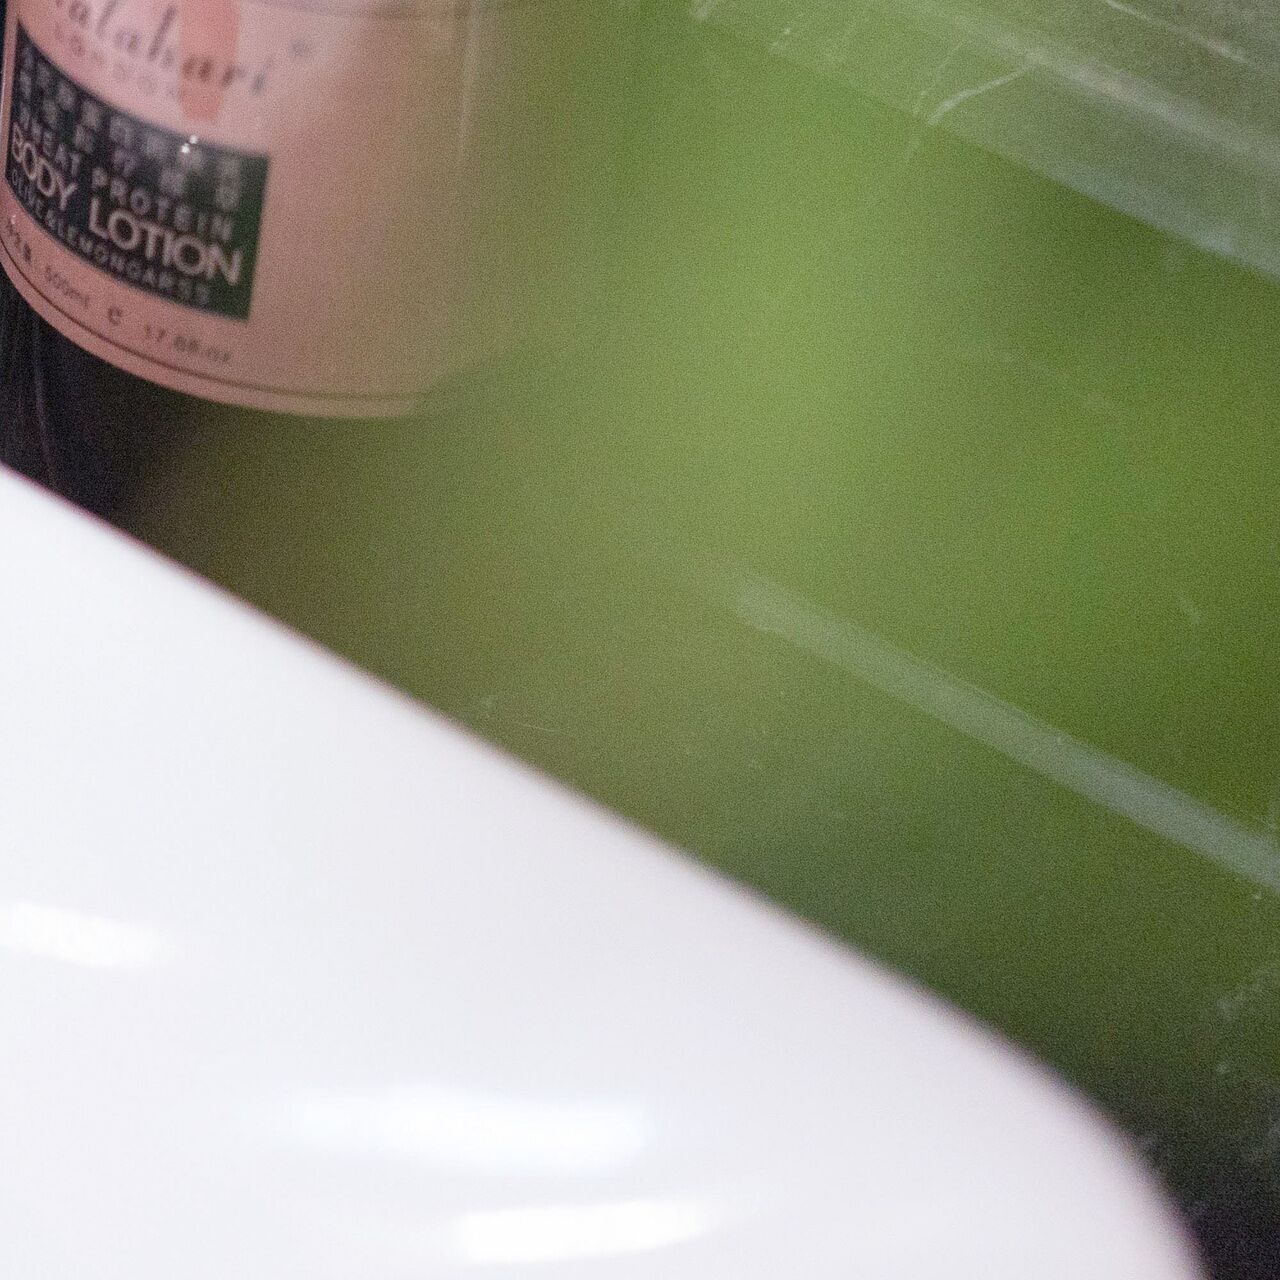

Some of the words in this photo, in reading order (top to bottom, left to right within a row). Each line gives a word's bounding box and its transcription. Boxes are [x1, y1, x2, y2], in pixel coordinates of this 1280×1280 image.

[11, 121, 79, 212] BODY
[88, 197, 242, 287] LOTION
[91, 165, 234, 243] PROTEIN
